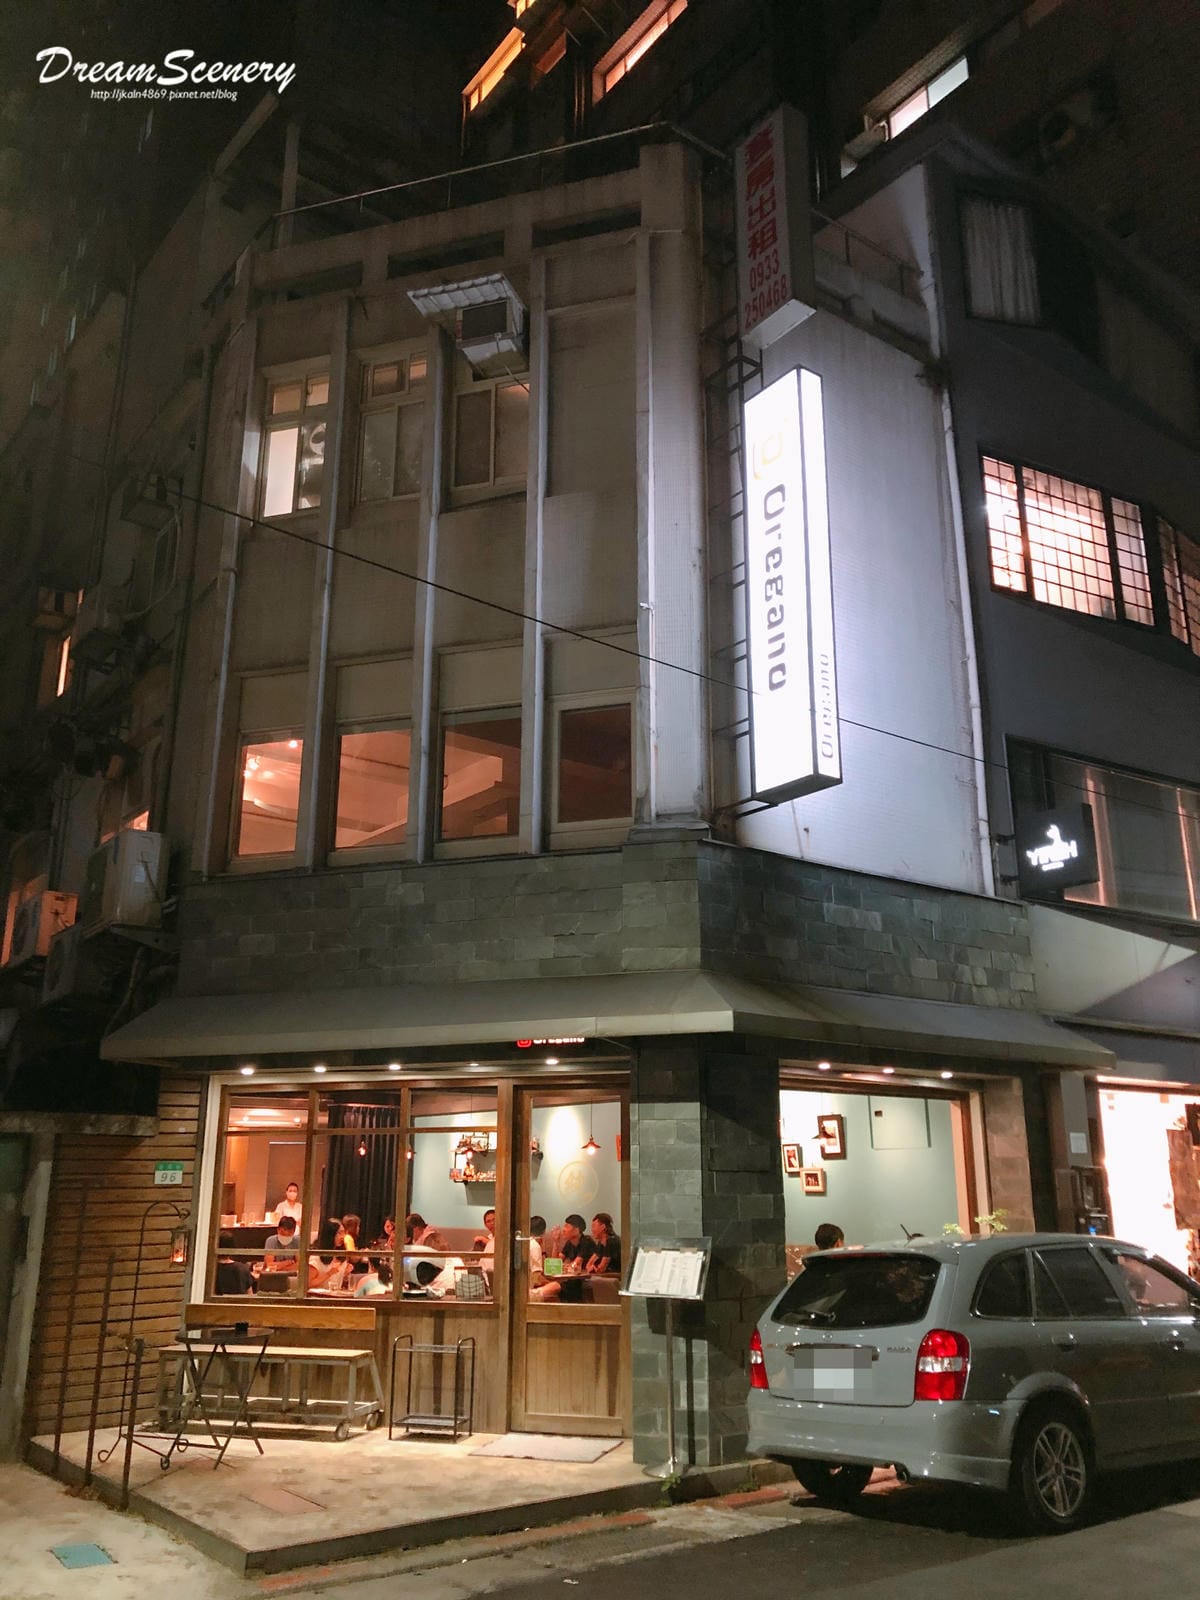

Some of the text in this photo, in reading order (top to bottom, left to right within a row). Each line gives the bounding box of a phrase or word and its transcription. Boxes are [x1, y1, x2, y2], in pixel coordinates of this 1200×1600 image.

[750, 248, 781, 292] 0933
[745, 274, 787, 329] 250468
[764, 484, 787, 691] Oregano
[161, 1172, 176, 1182] 96
